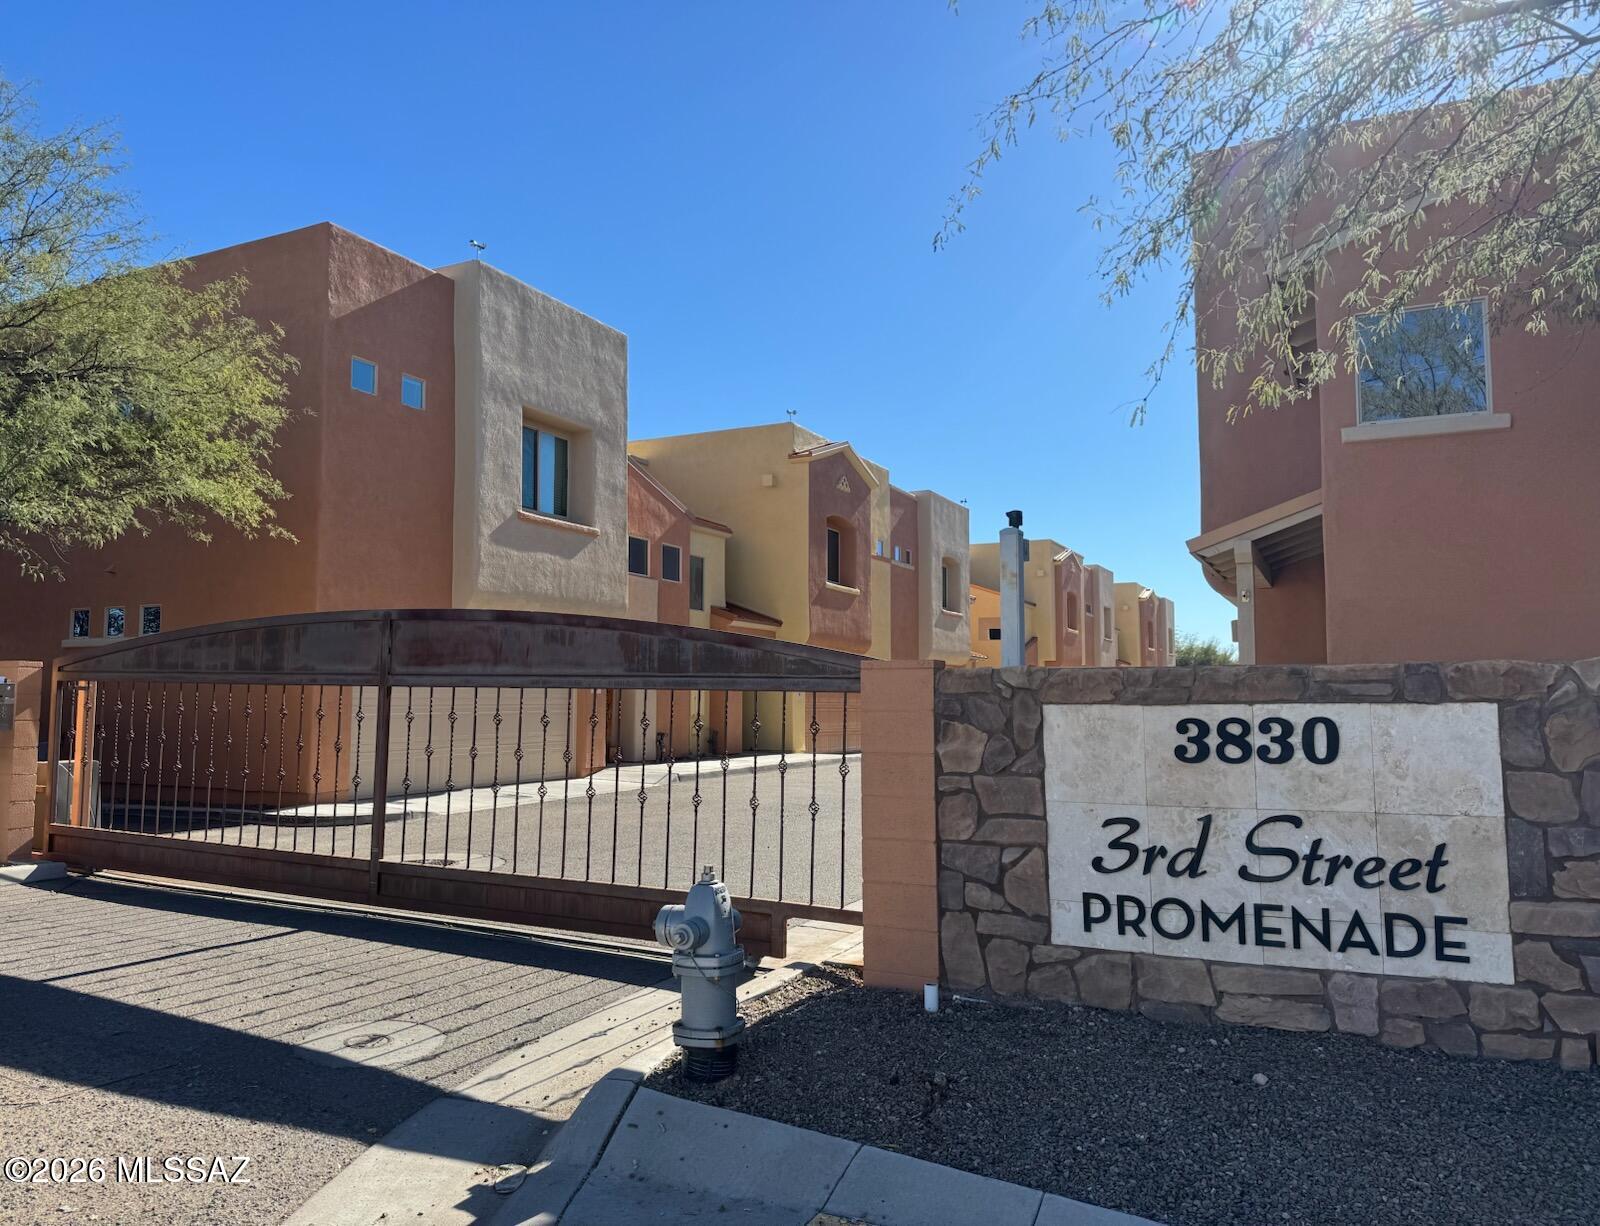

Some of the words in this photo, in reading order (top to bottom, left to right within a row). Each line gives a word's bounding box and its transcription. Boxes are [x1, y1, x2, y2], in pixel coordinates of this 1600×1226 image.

[1173, 716, 1340, 765] 3830
[1091, 814, 1213, 879] 3rd
[1238, 814, 1449, 894] Street
[1082, 892, 1471, 964] PROMENADE
